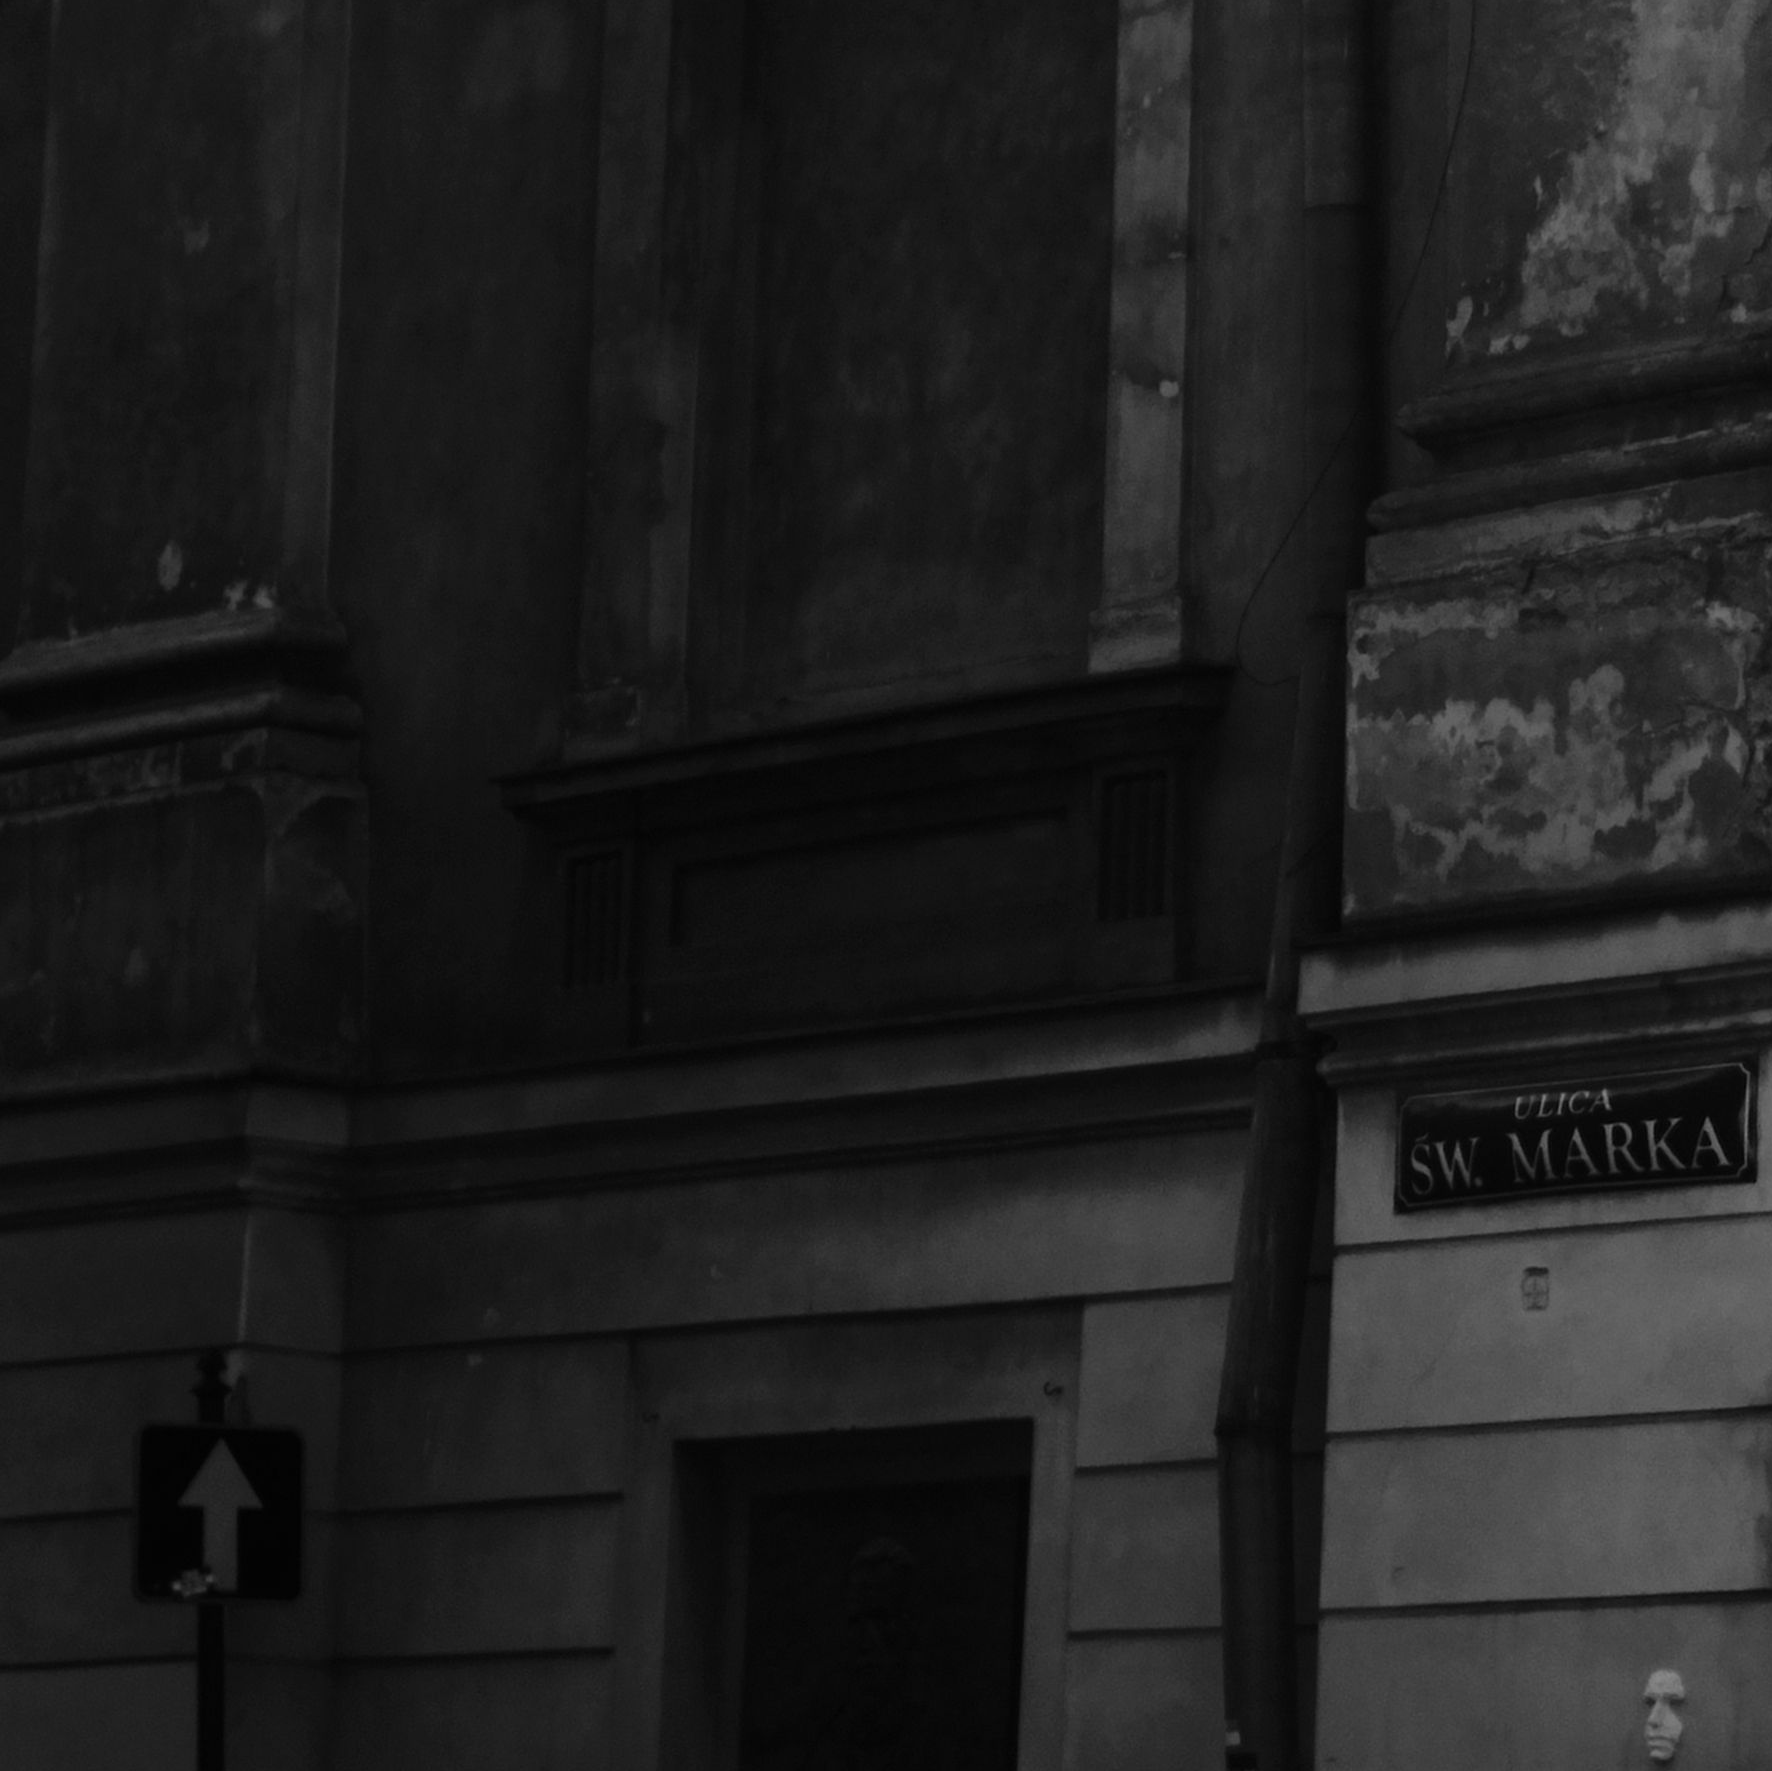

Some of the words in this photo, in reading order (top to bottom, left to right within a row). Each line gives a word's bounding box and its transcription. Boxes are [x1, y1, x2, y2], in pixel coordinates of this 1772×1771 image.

[1512, 1088, 1613, 1120] ULICA
[1409, 1130, 1484, 1196] ŚW.
[1504, 1115, 1731, 1184] MARKA
